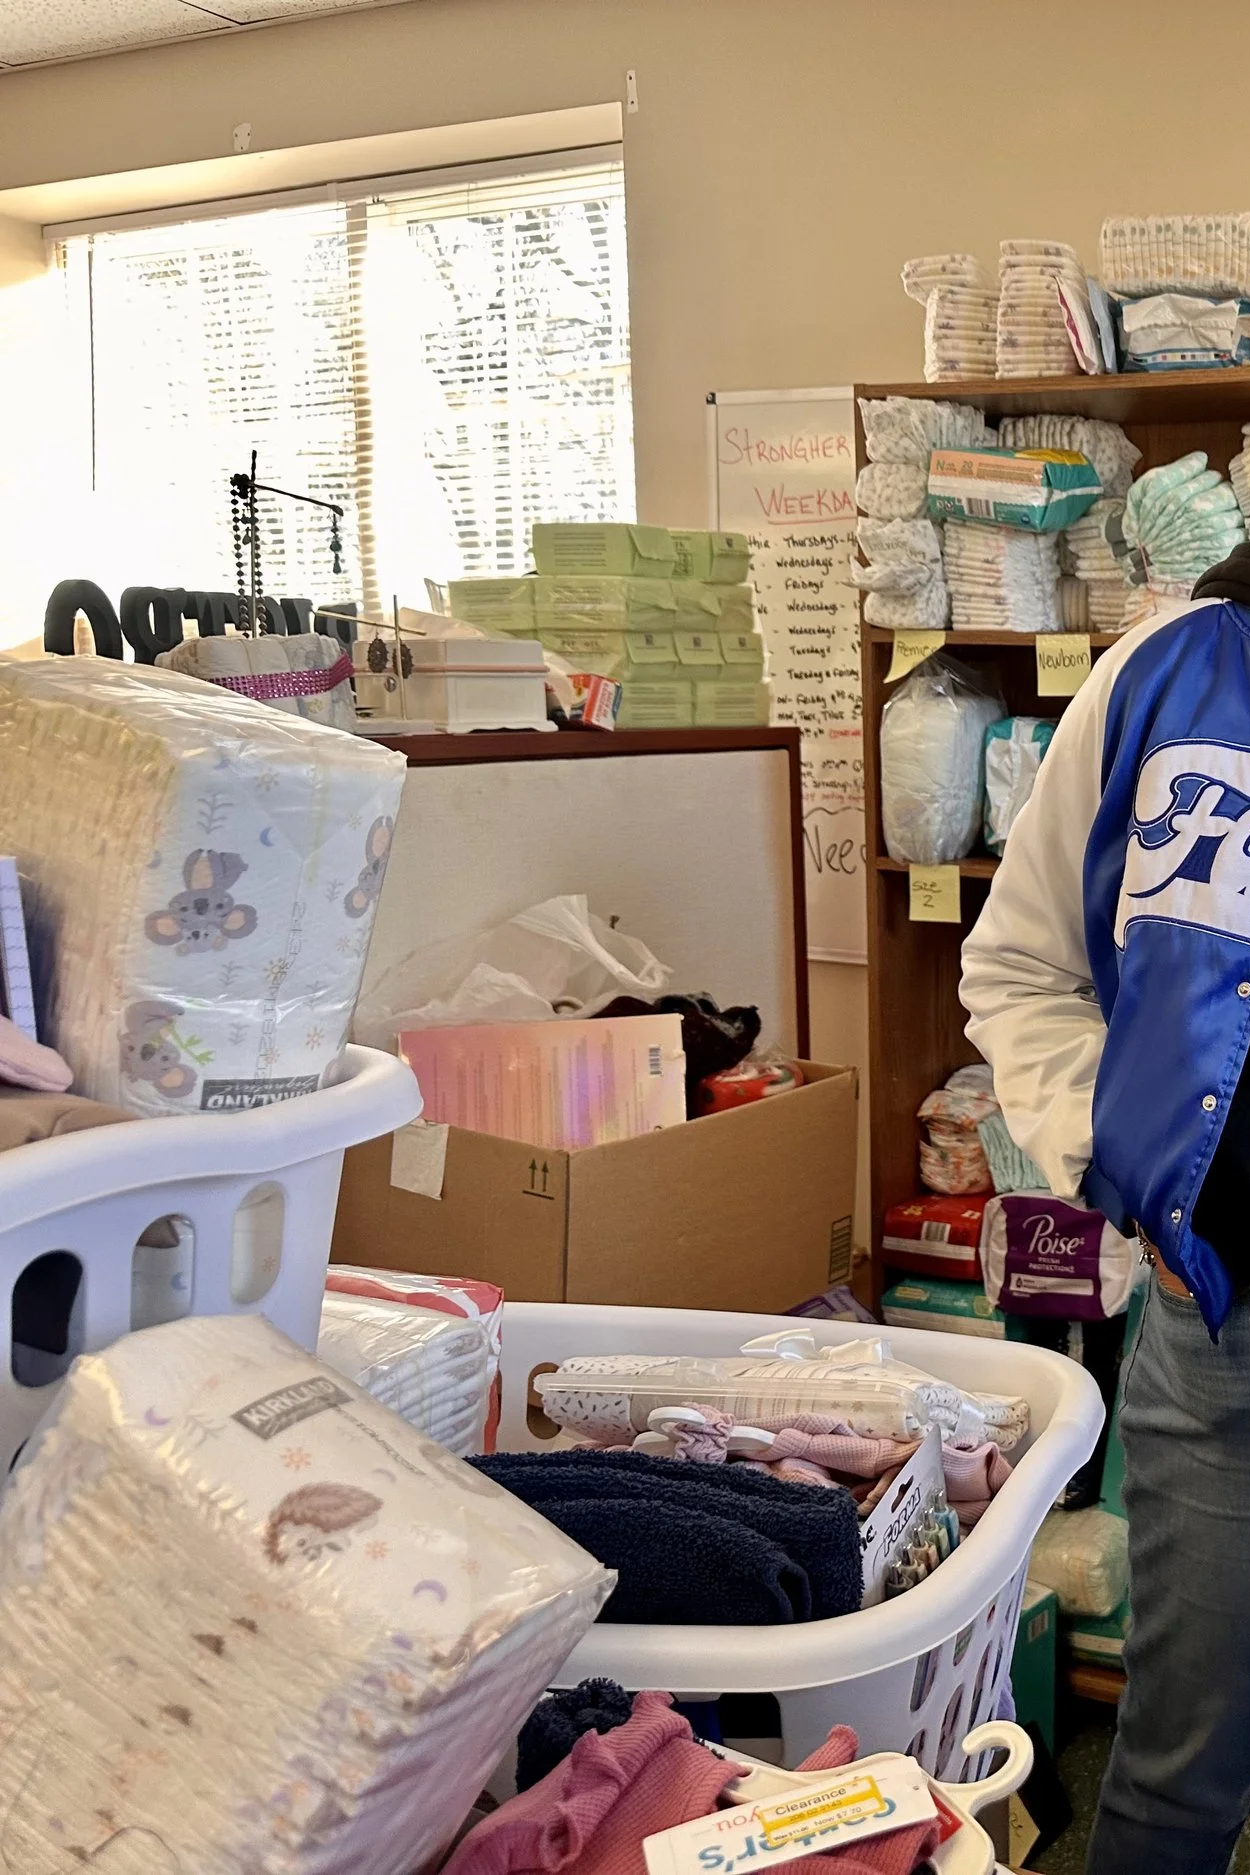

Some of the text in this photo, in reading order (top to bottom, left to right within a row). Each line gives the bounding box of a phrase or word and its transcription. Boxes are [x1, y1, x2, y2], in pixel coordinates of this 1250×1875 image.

[718, 428, 851, 465] STRONGHER
[923, 894, 935, 908] 2
[1022, 1214, 1081, 1256] Poise
[775, 1787, 847, 1817] Clearance
